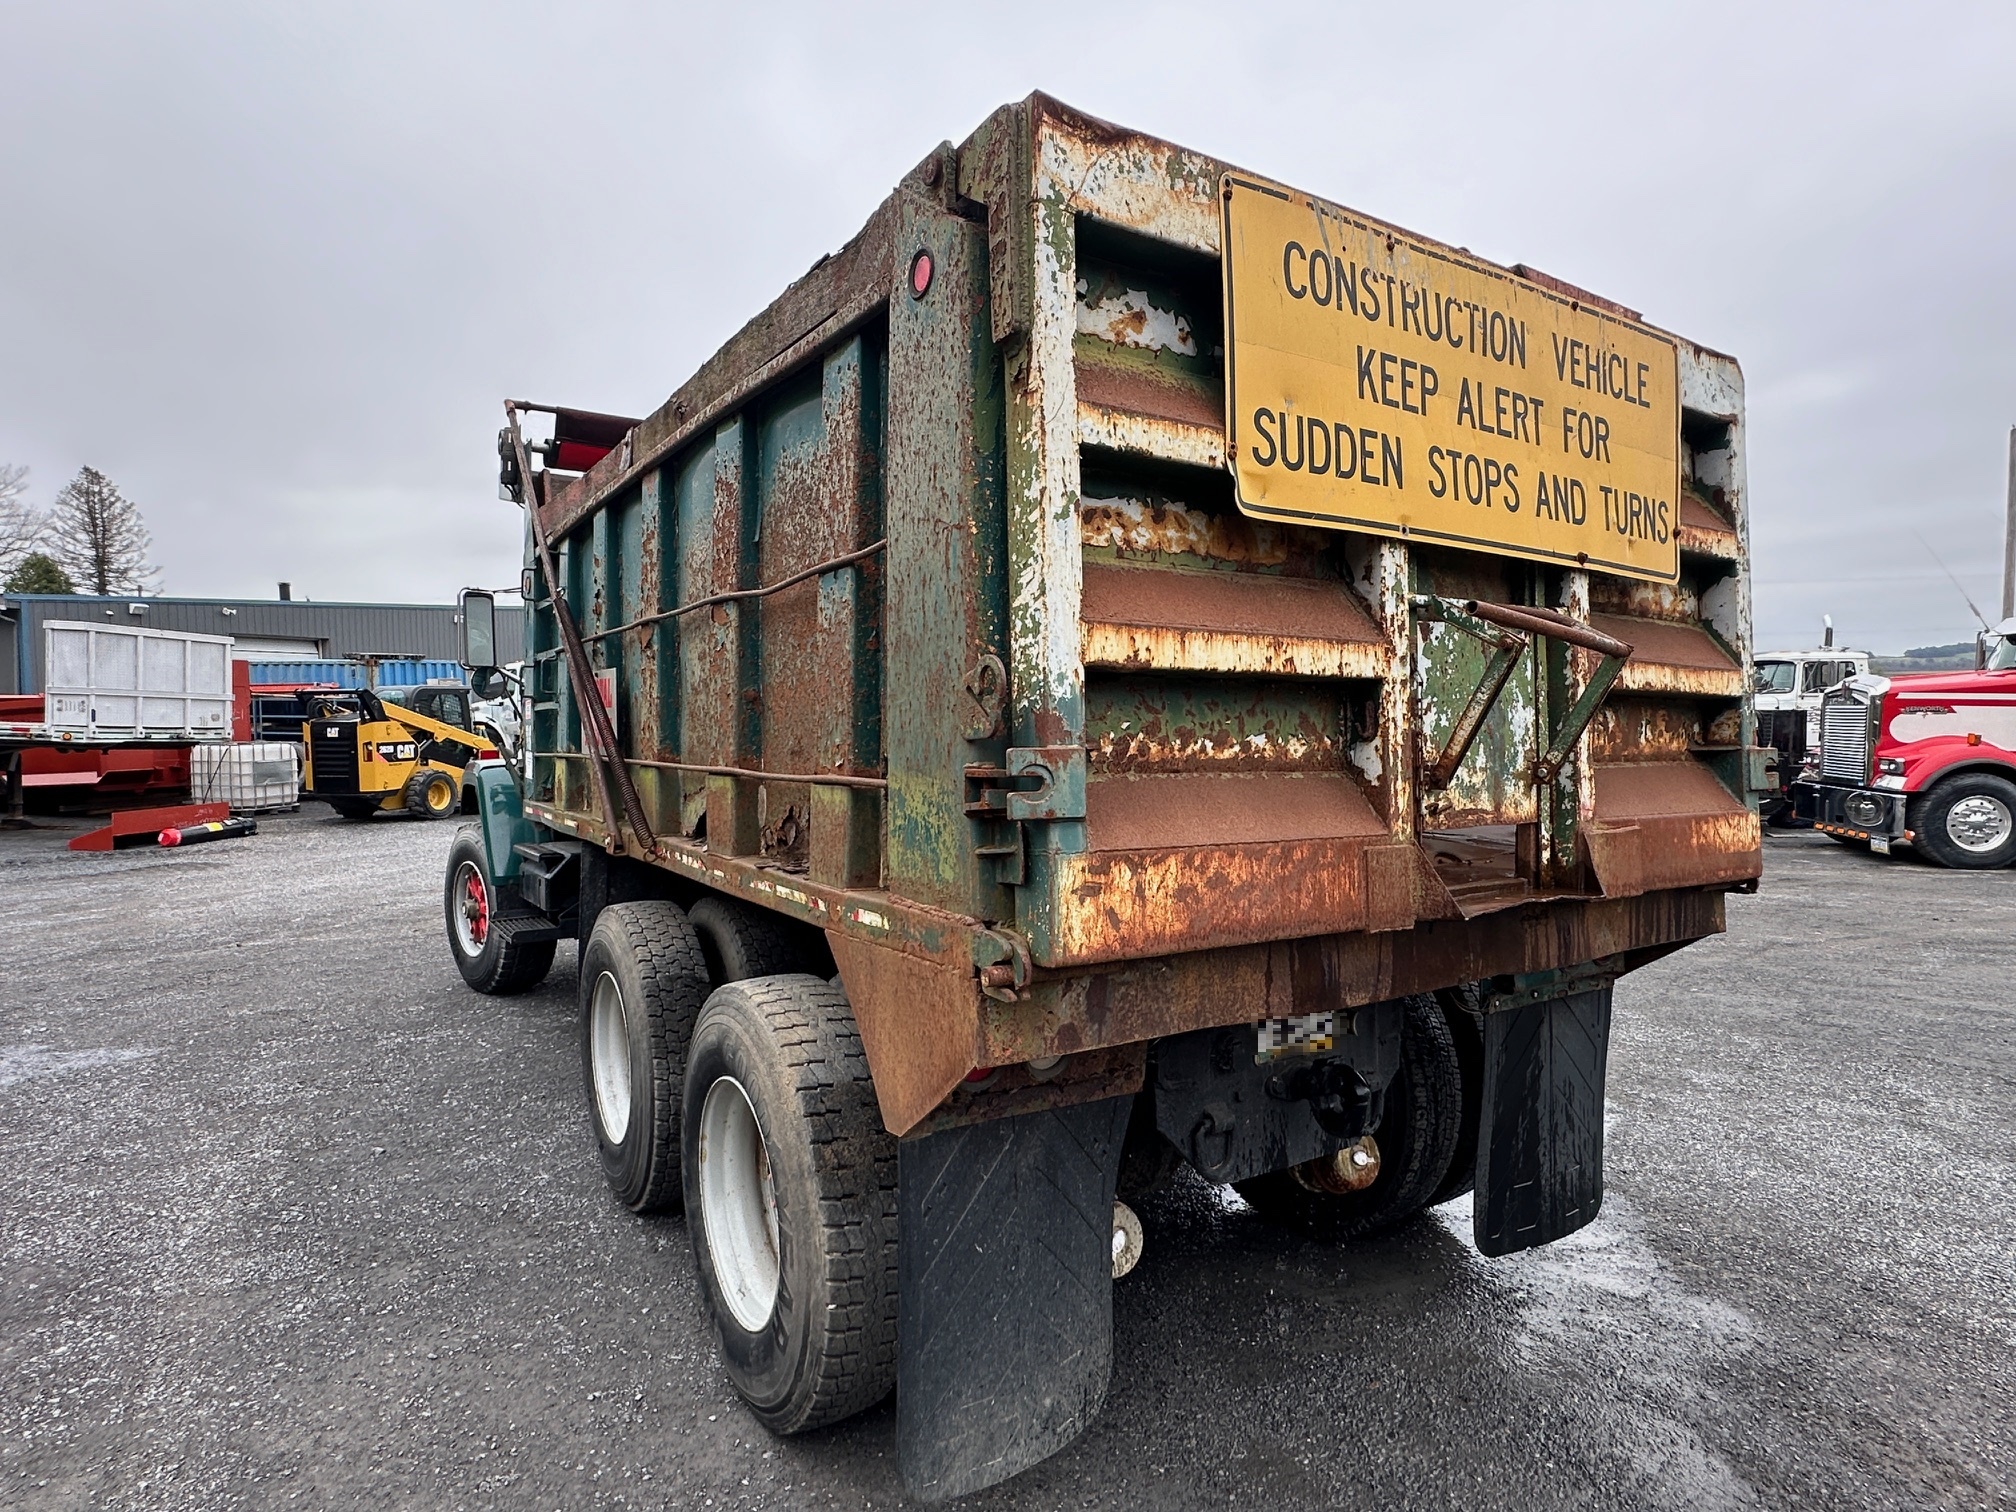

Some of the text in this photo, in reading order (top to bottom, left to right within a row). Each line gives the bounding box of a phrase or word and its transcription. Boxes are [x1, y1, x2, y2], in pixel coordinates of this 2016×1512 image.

[1283, 240, 1650, 408] CONSTRUCTION VEHICLE
[1357, 345, 1611, 463] KEEP ALERT FOR
[1252, 407, 1669, 545] SUDDEN STOPS AND TURNS
[326, 727, 339, 738] CAT
[397, 744, 416, 759] CAT
